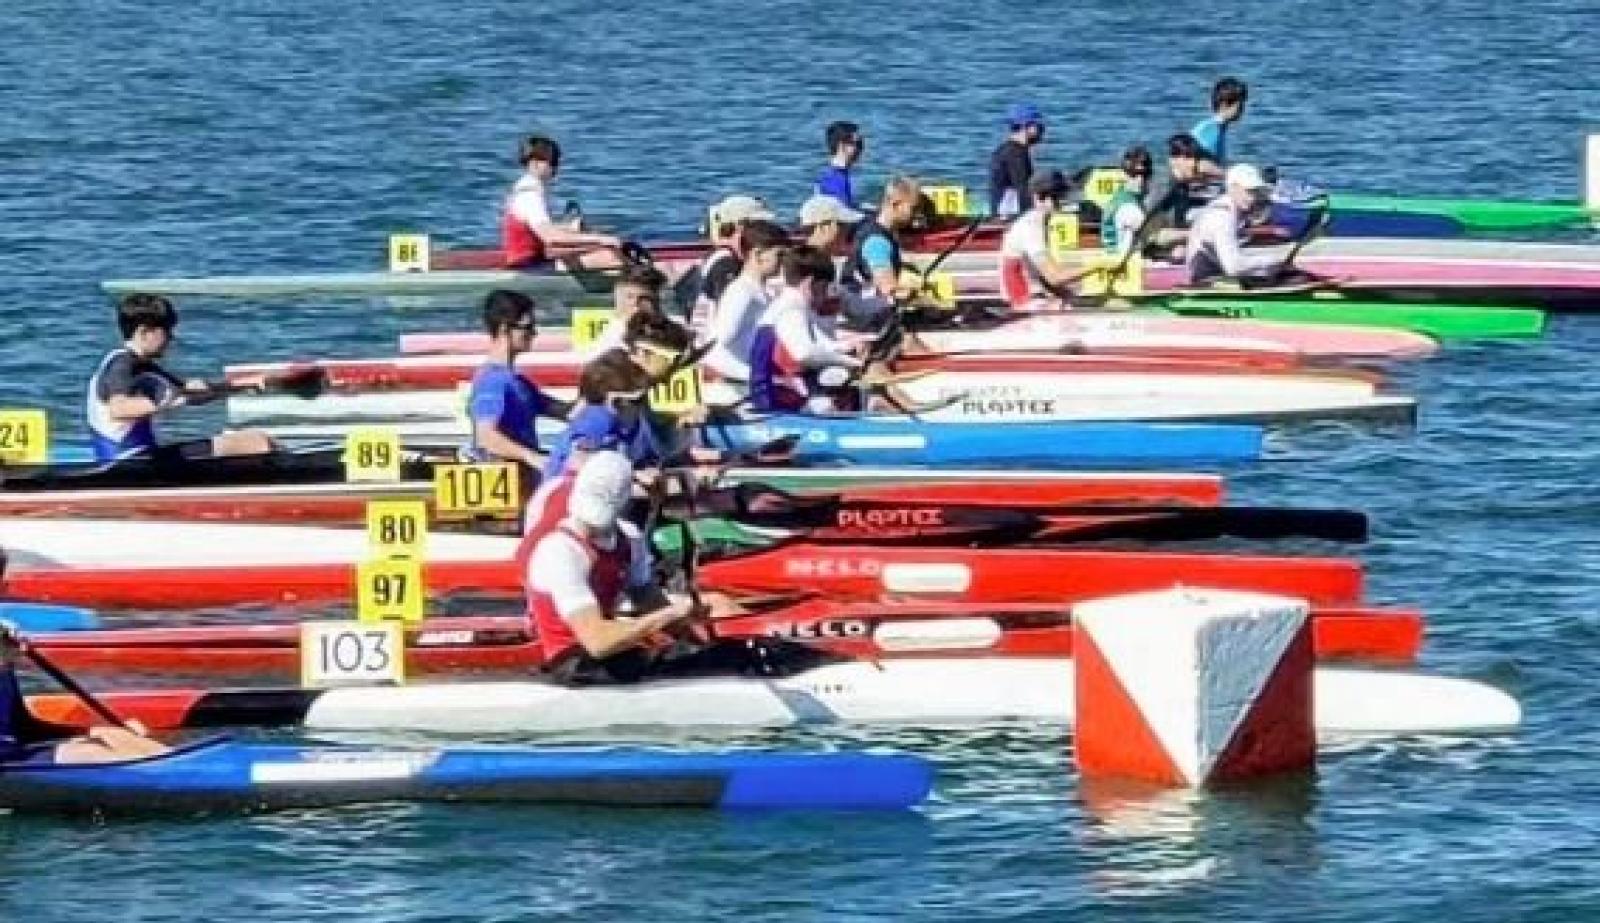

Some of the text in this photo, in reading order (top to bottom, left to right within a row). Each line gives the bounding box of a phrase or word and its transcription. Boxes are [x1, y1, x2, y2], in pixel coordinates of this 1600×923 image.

[357, 441, 391, 468] 89
[443, 467, 511, 508] 104
[379, 514, 416, 544] 80
[372, 574, 406, 606] 97
[320, 630, 391, 673] 103
